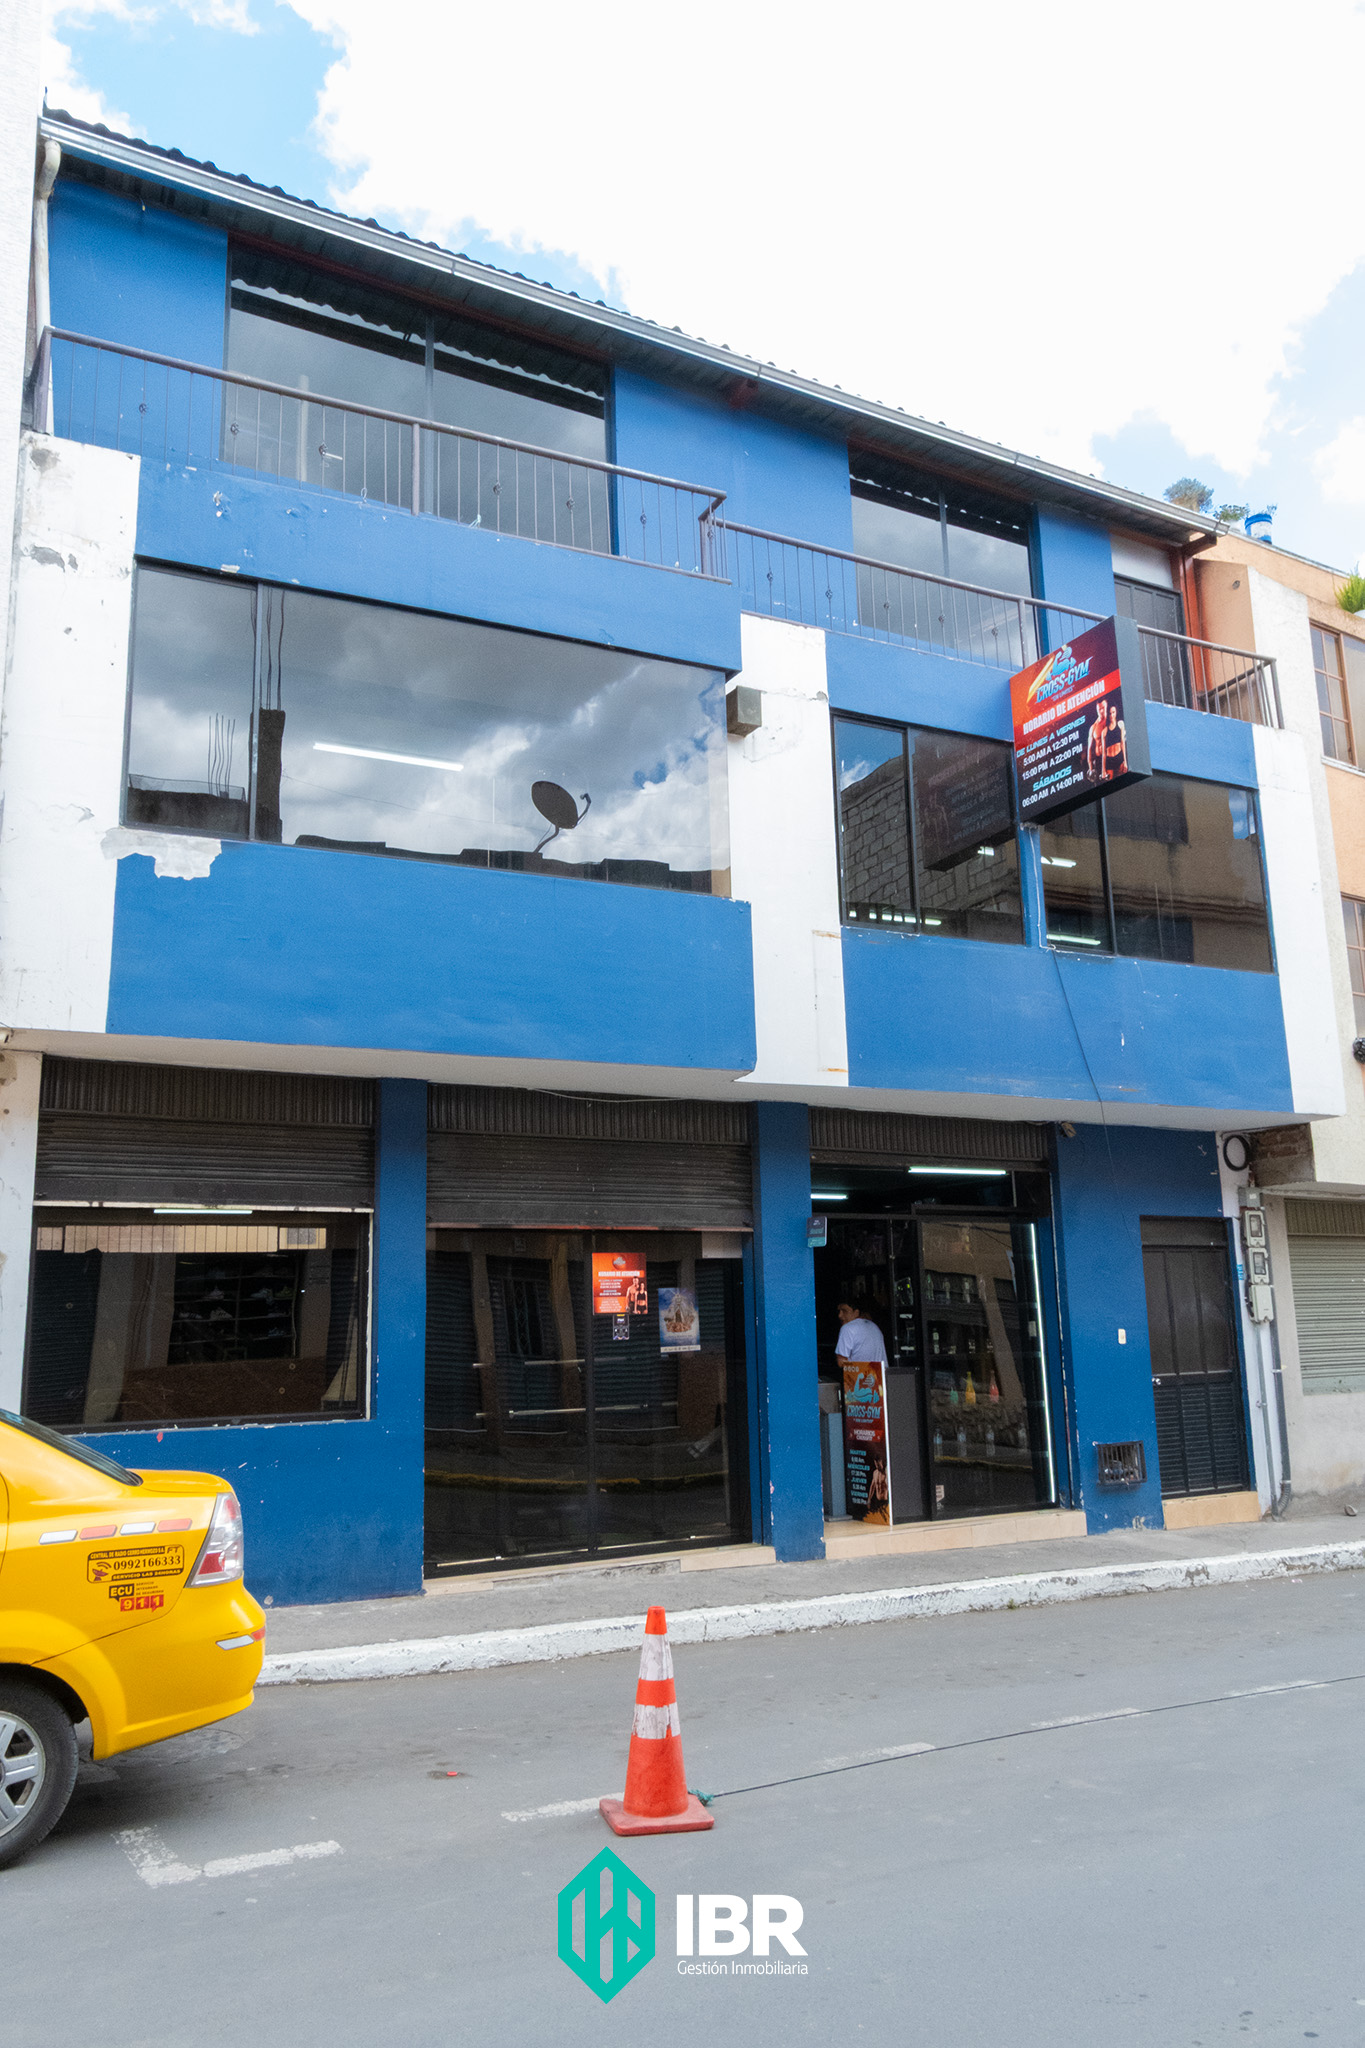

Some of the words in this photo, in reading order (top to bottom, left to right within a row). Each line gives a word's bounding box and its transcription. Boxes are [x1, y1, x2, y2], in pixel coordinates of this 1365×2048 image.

[1035, 656, 1093, 703] CROSS-GYM
[1023, 708, 1056, 735] HORARIO
[1056, 701, 1067, 717] DE
[1067, 680, 1105, 711] ATENCIÓN
[1016, 747, 1025, 758] DE
[1026, 735, 1048, 753] LUNES
[1049, 732, 1055, 741] A
[1056, 715, 1086, 737] VIERNES
[1023, 753, 1036, 766] 5:00
[1036, 749, 1046, 760] AM
[1046, 745, 1052, 755] A
[1052, 737, 1068, 751] 12:30
[1068, 730, 1080, 743] PM
[1022, 767, 1038, 780] 15:00
[1038, 761, 1048, 773] PM
[1049, 758, 1056, 767] A
[1055, 750, 1072, 764] 22:00
[1072, 743, 1083, 756] PM
[1032, 765, 1072, 792] SÁBADOS
[1022, 794, 1038, 808] 06:00
[1038, 788, 1049, 800] AM
[1050, 785, 1056, 795] A
[1056, 777, 1073, 791] 14:00
[1073, 771, 1084, 784] PM
[112, 1573, 141, 1581] SERVICIO
[113, 1555, 181, 1571] 0992166333
[110, 1585, 133, 1597] ECU
[123, 1596, 160, 1610] 911
